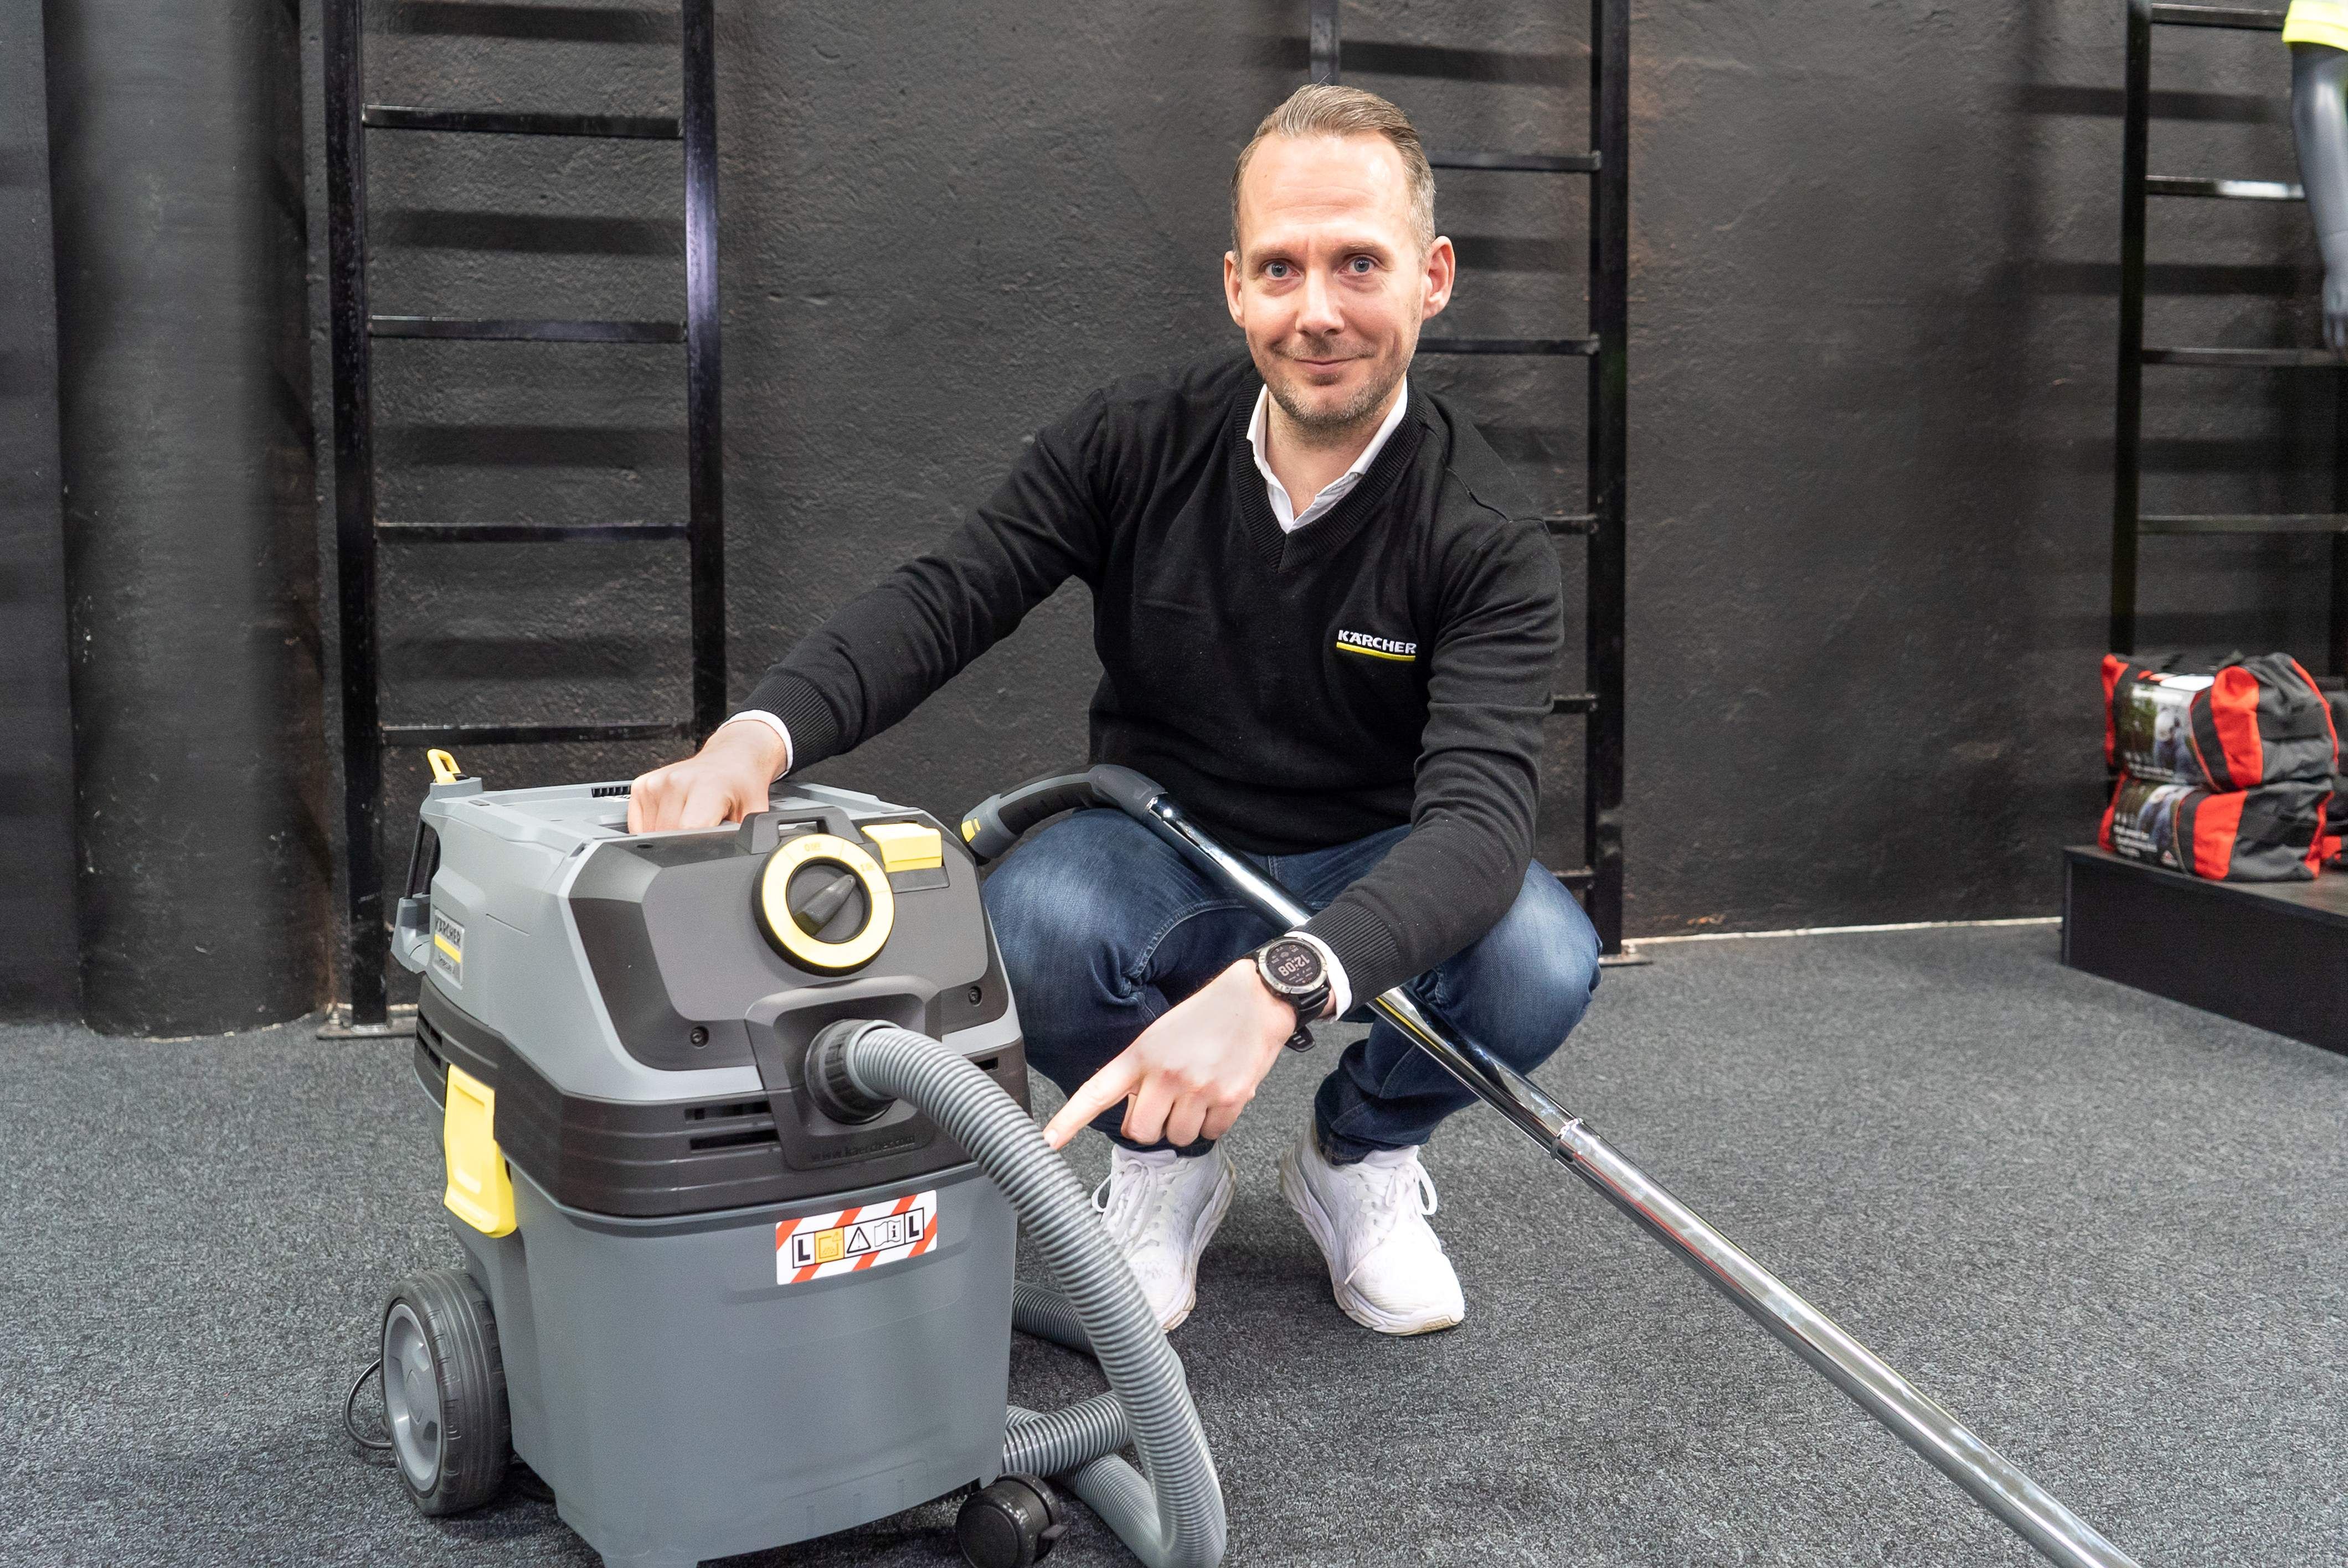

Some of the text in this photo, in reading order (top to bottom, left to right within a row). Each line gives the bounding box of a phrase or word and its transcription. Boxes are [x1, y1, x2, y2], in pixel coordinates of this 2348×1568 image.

[1338, 630, 1417, 654] KÄRCHER
[1278, 954, 1310, 976] 12:08
[798, 1239, 810, 1262] L
[909, 1216, 919, 1238] L
